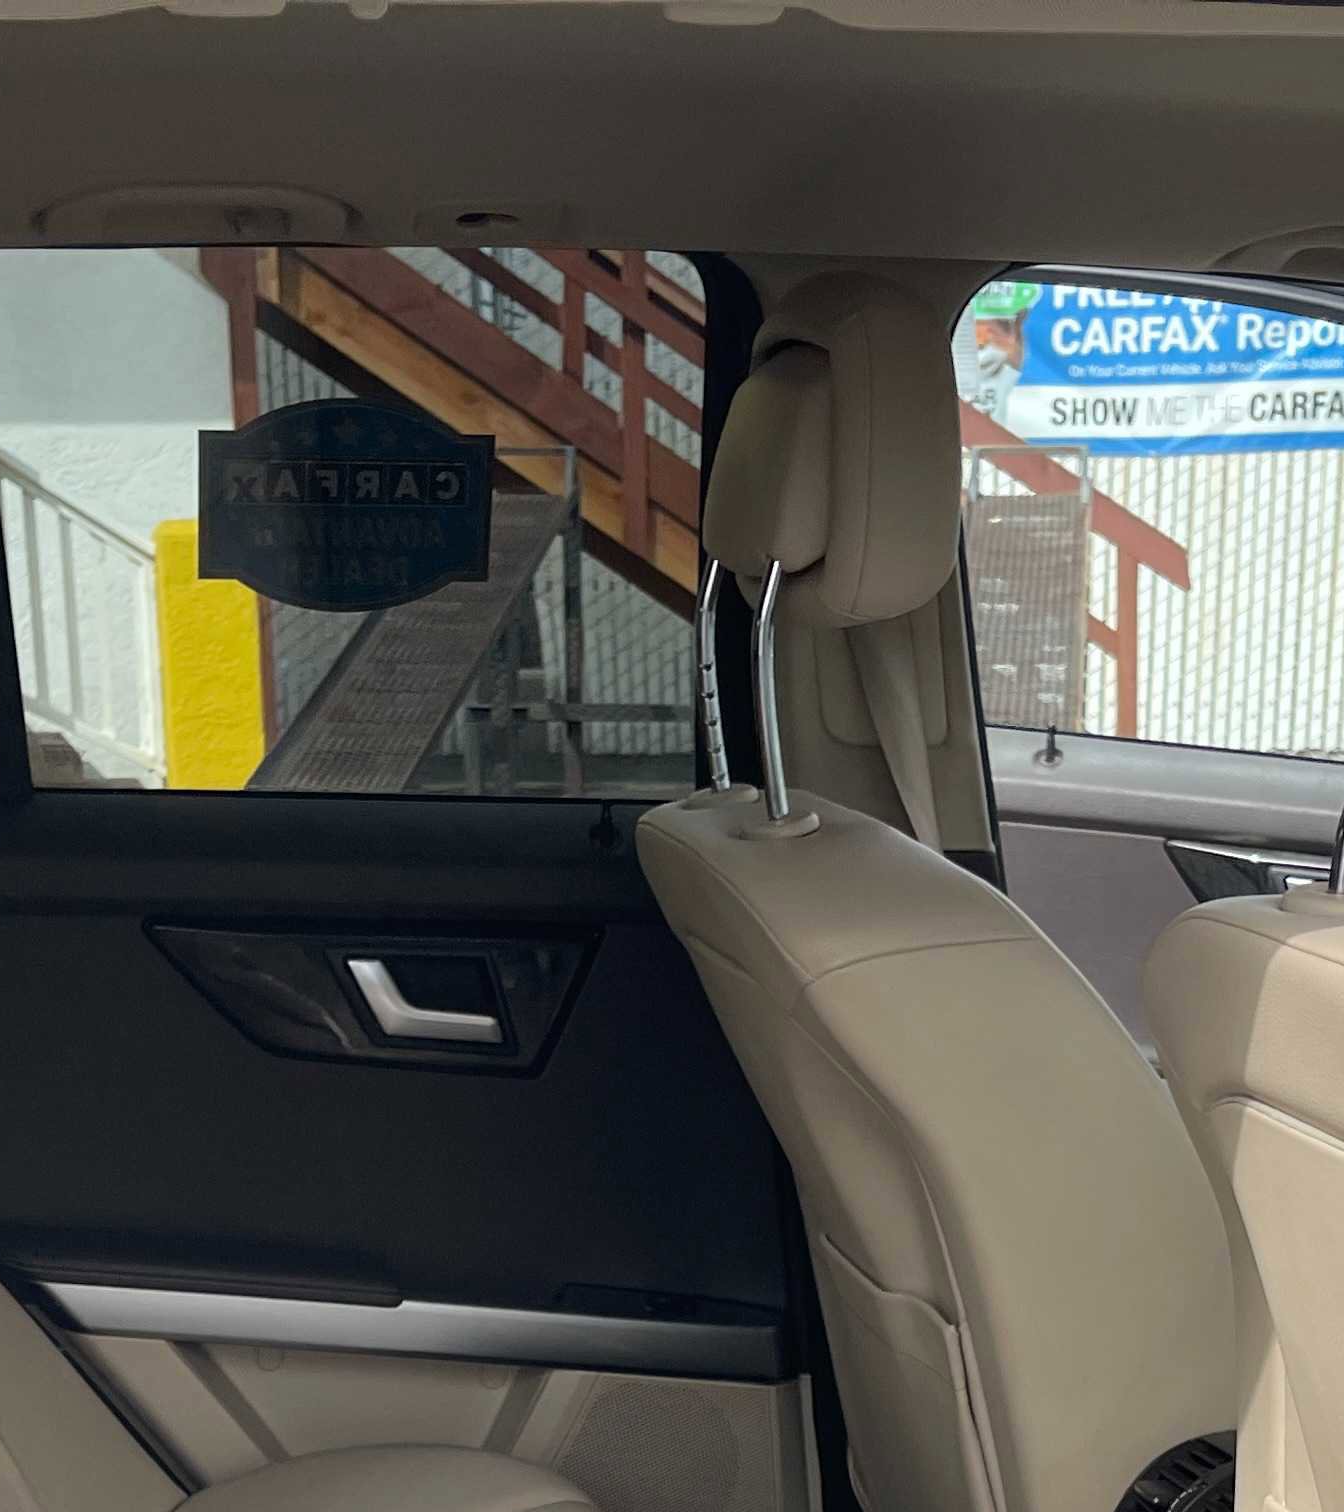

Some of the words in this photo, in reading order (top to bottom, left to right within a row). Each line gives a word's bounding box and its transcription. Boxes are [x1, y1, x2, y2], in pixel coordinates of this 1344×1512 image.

[1051, 315, 1220, 355] CARFAX
[1051, 397, 1138, 427] SHOW
[1146, 395, 1187, 426] ME
